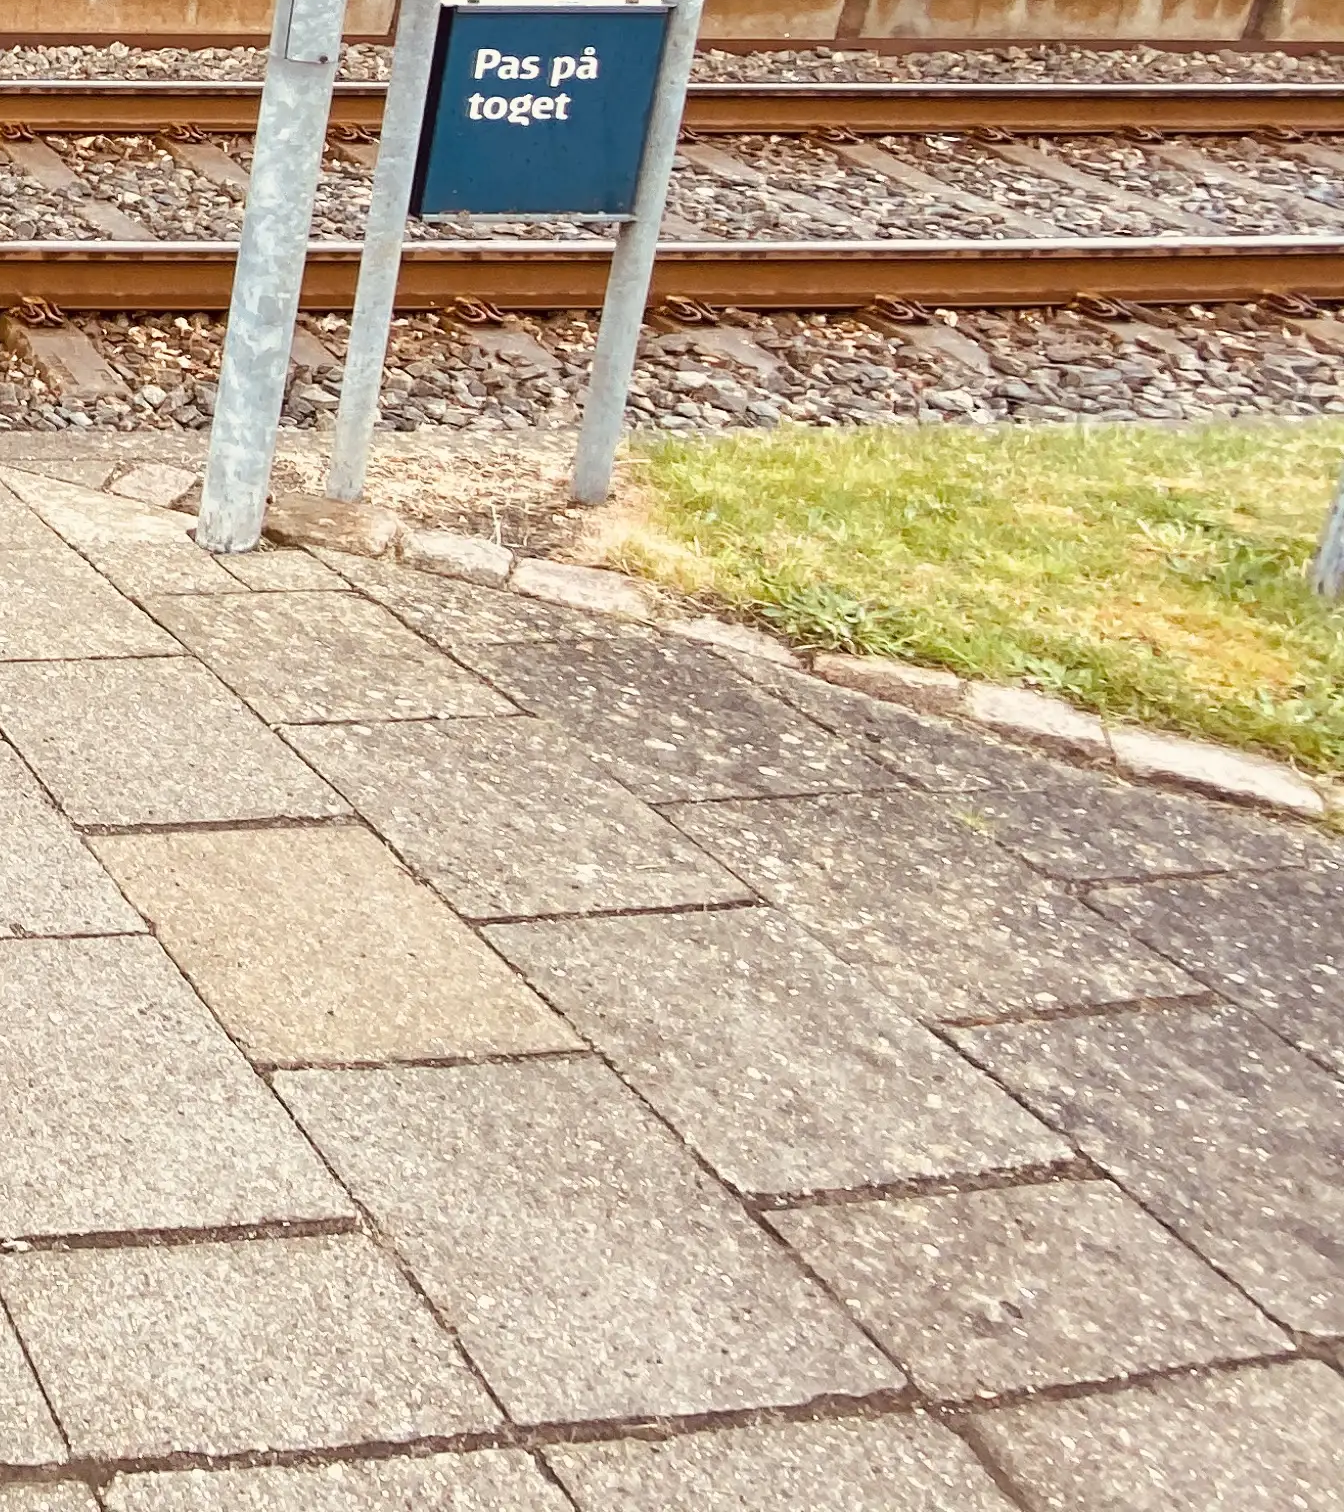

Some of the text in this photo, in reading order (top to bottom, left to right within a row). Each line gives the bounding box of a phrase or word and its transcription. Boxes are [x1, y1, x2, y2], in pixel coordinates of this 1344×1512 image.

[473, 46, 599, 88] Pas på
[468, 92, 572, 126] toget
